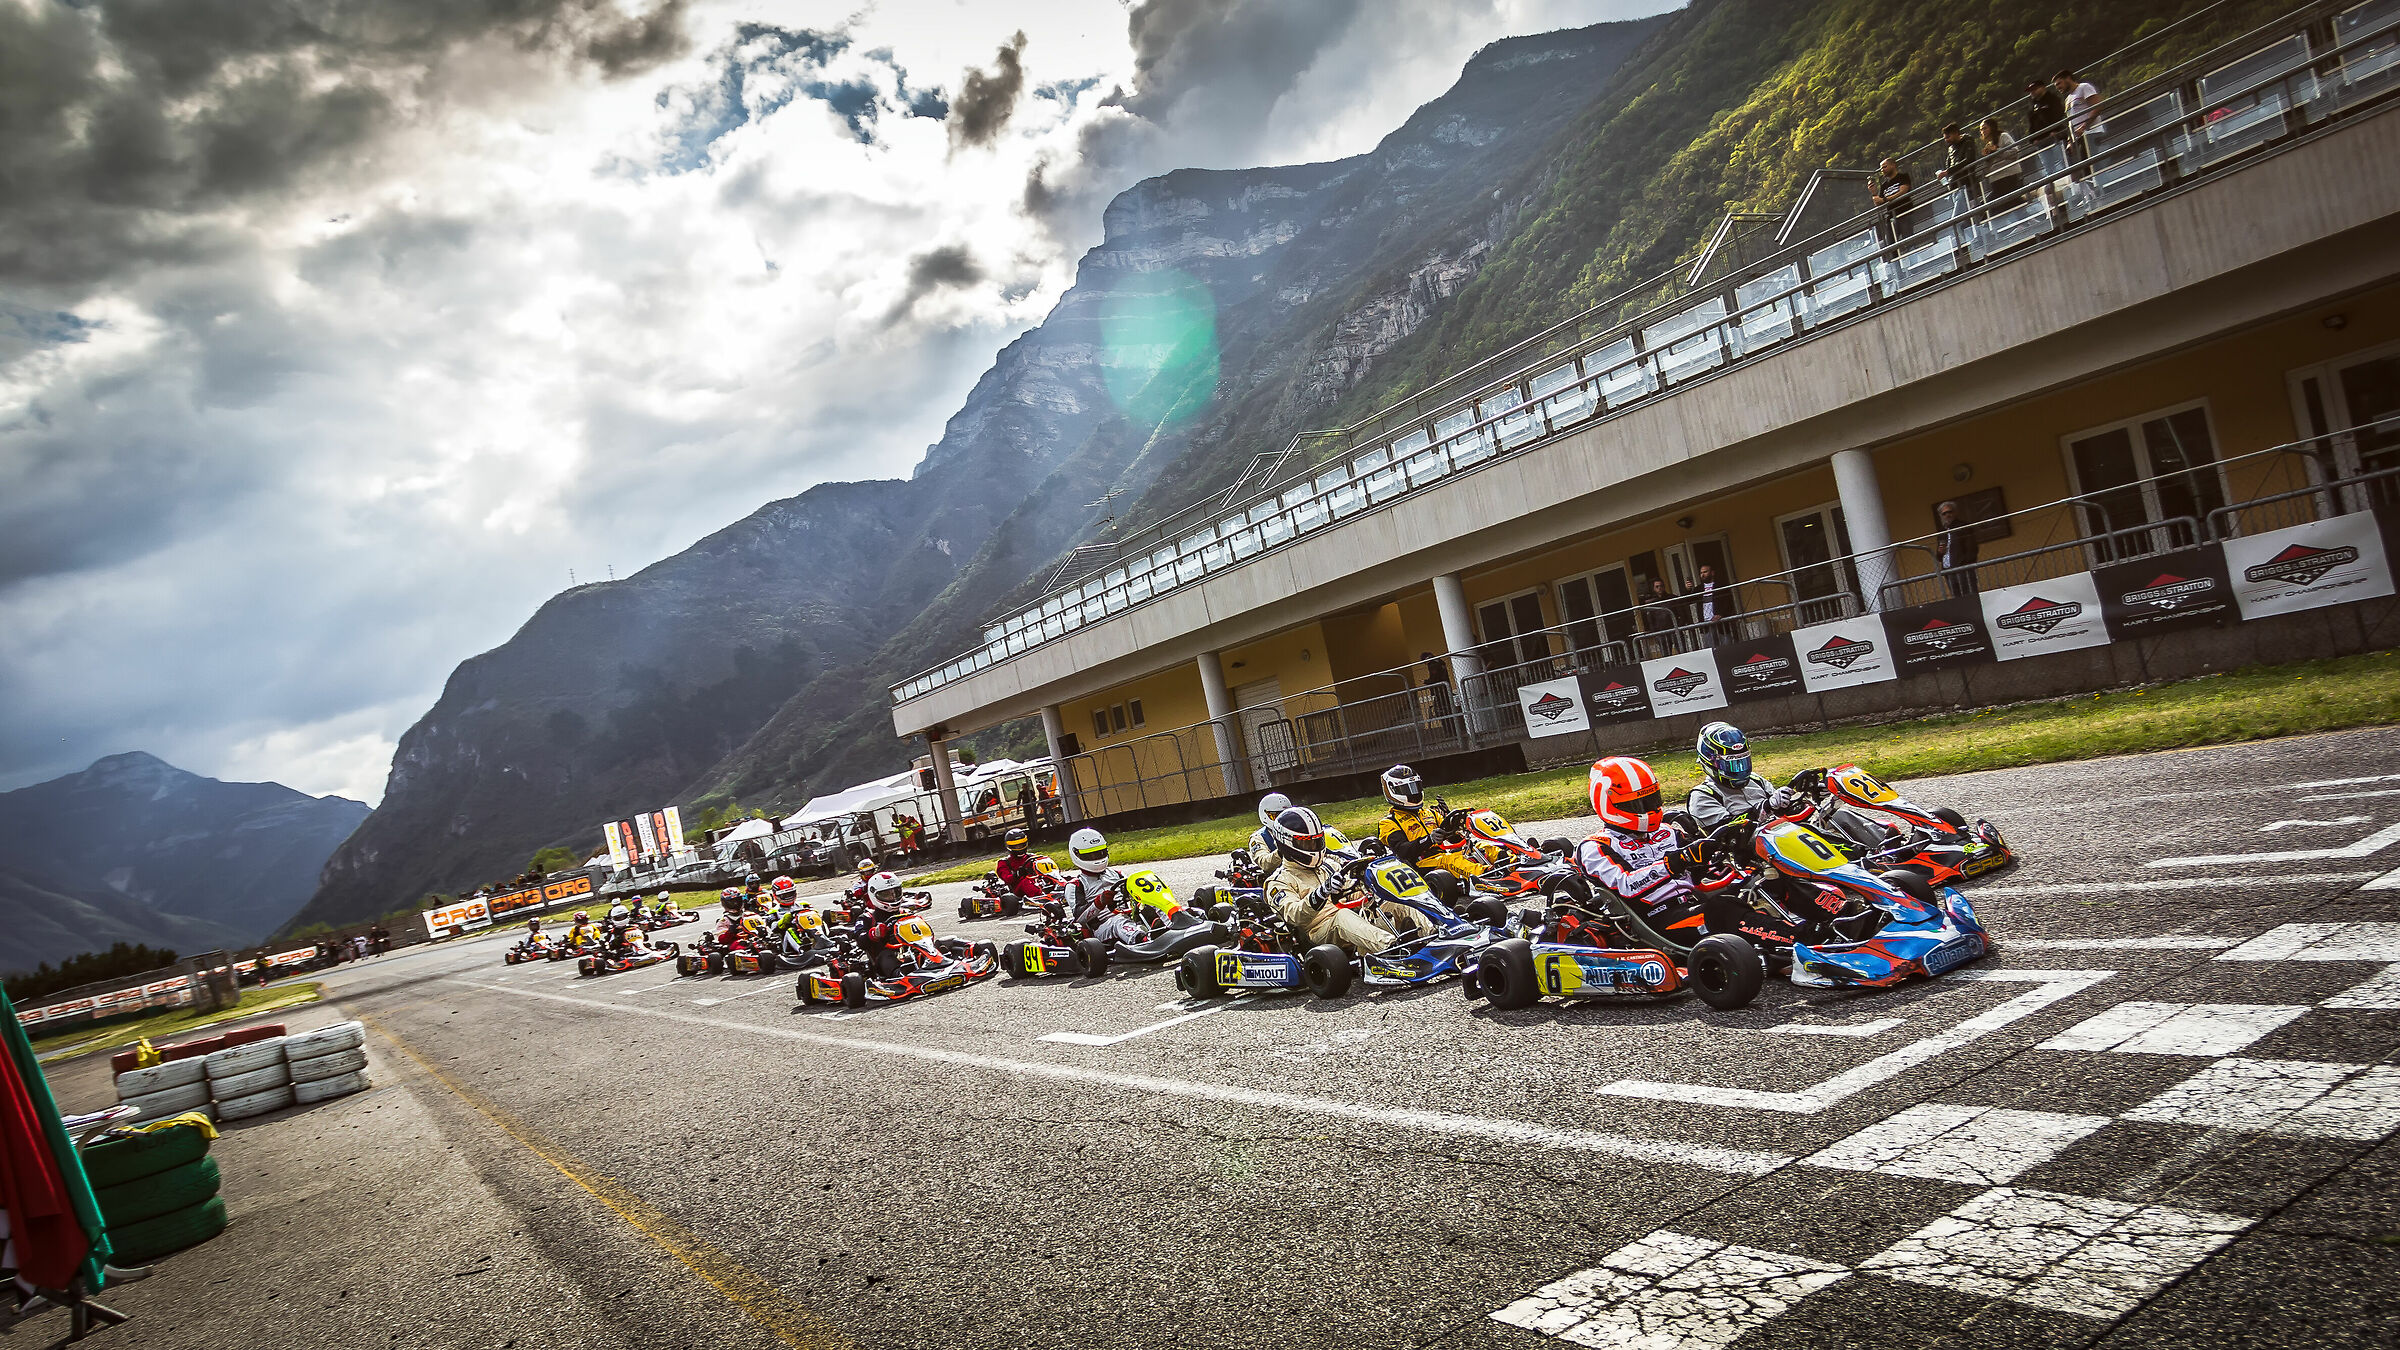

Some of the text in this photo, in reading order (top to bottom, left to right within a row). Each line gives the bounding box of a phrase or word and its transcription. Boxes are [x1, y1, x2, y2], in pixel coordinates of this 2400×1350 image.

[1482, 816, 1507, 832] 52
[1797, 833, 1835, 861] 6
[1966, 854, 2004, 875] CRG
[544, 877, 592, 900] CRG
[1385, 867, 1426, 895] 122
[1629, 875, 1650, 892] Allianz
[489, 888, 543, 913] CRG
[431, 903, 486, 927] CRG
[808, 915, 816, 925] 5
[911, 923, 922, 936] 4
[276, 949, 316, 964] CRG
[1025, 946, 1040, 971] 94
[1218, 954, 1238, 984] 122
[1254, 969, 1285, 979] MIOUT
[1371, 966, 1416, 978] CRG
[1545, 955, 1562, 994] 6
[1585, 968, 1638, 986] Allianz
[925, 976, 963, 992] CRG
